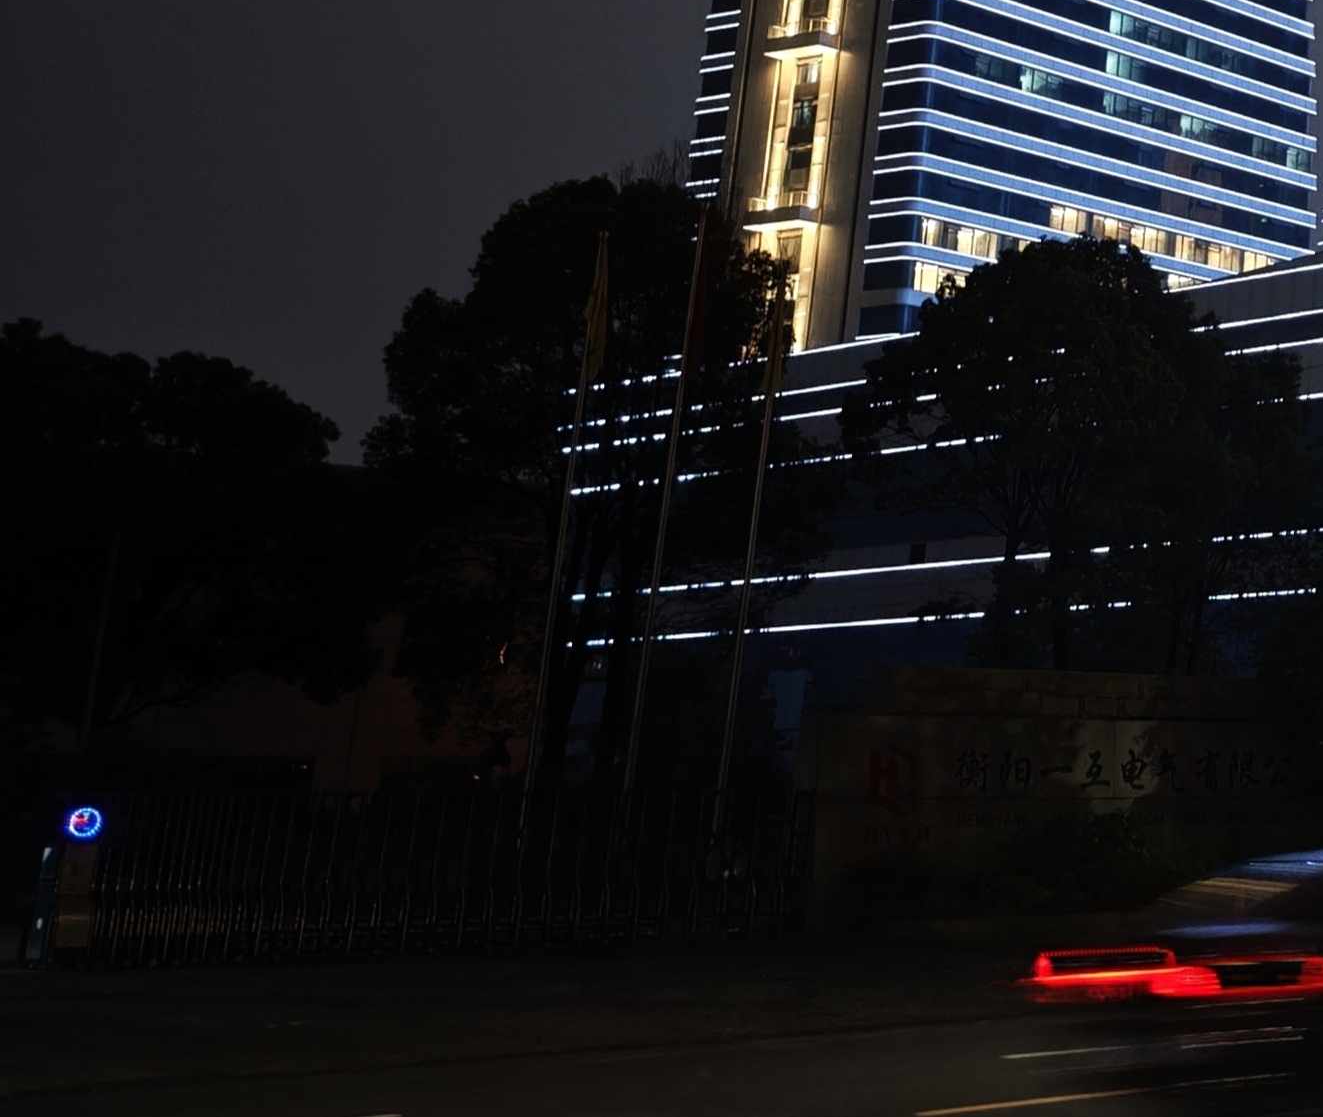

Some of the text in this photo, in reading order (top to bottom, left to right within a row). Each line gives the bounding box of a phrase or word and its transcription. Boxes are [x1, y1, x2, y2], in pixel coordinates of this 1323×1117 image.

[955, 747, 1292, 794] 衡阳一互电气有限公
